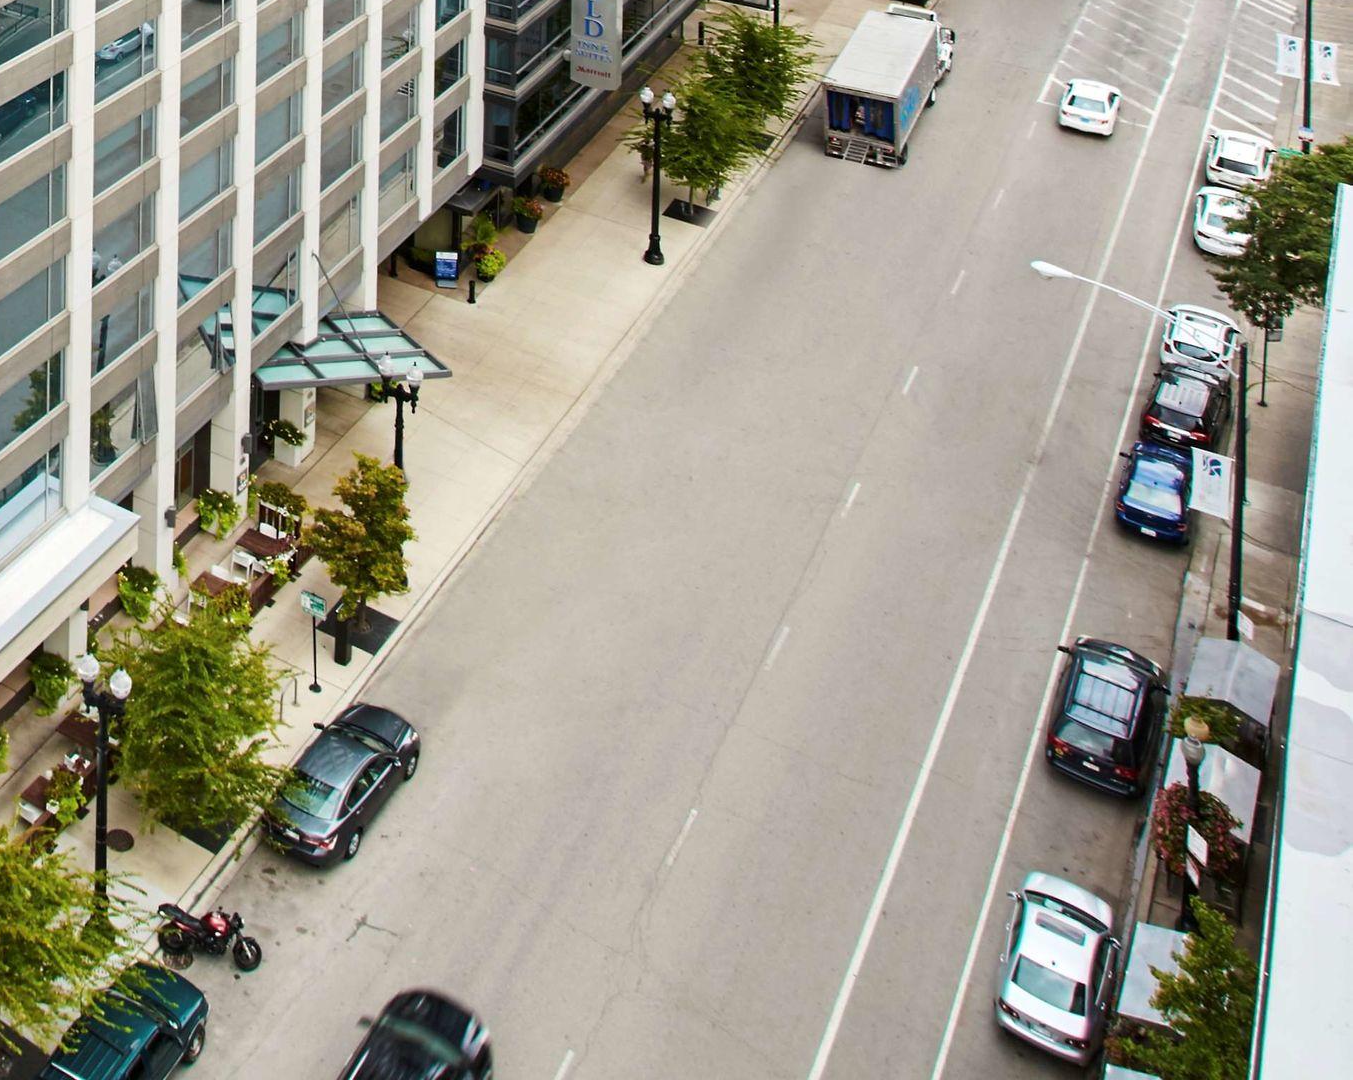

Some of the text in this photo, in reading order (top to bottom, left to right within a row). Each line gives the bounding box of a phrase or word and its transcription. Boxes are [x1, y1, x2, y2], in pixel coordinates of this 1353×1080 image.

[577, 40, 598, 51] INN
[575, 49, 613, 63] SUITES
[576, 65, 611, 78] Marriott
